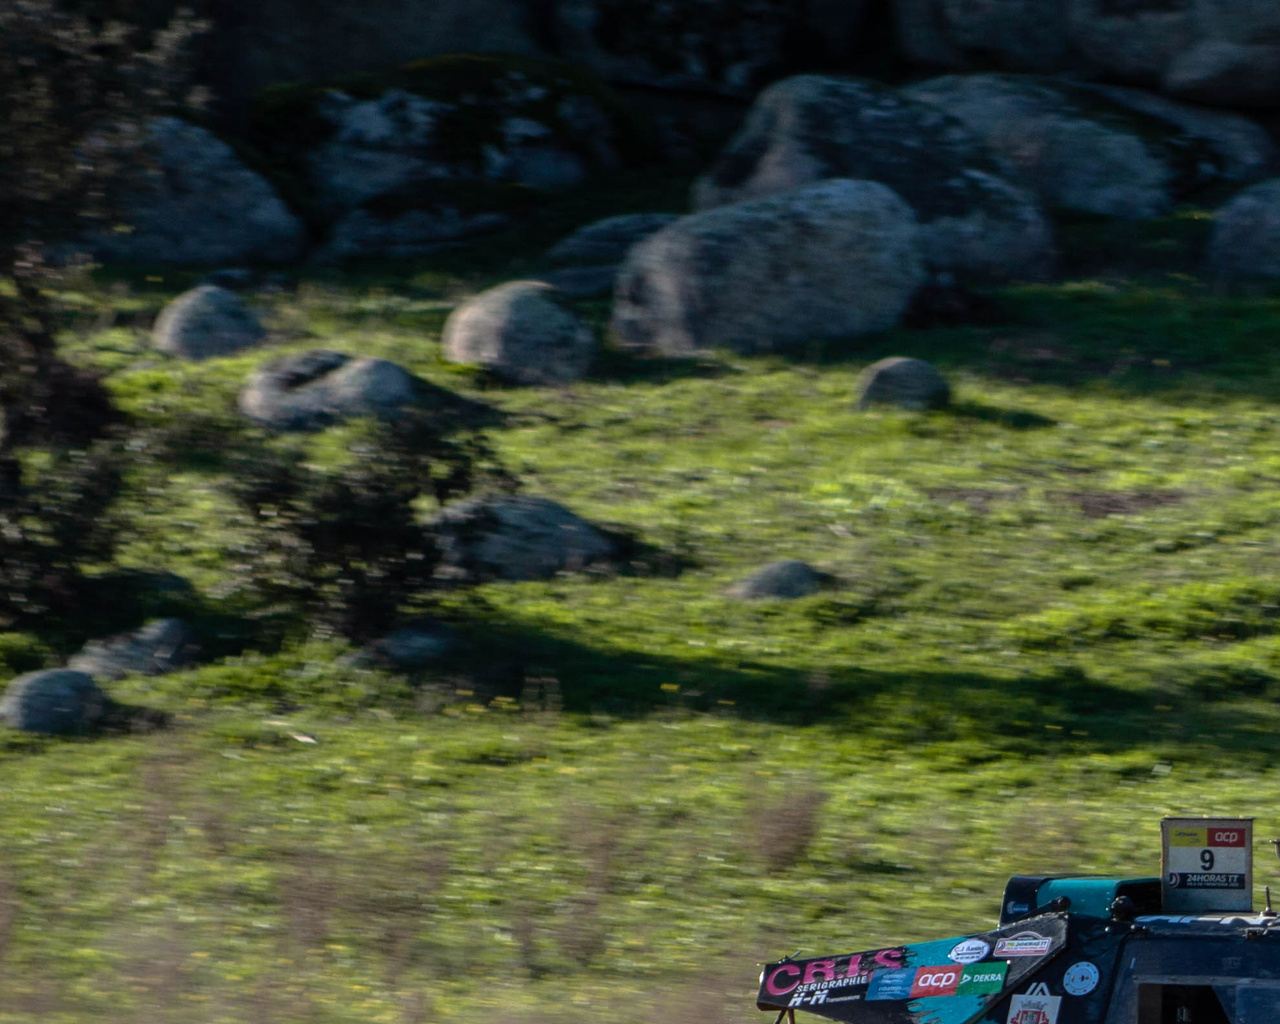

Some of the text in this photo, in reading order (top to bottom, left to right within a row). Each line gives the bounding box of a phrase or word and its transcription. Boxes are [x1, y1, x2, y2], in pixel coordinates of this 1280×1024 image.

[1215, 832, 1238, 843] acp
[1200, 849, 1214, 871] 9
[1186, 874, 1239, 883] 24HORAS TT
[796, 975, 868, 993] SERIGRAPHIE
[917, 972, 956, 988] acp
[973, 972, 1003, 984] DEKRA
